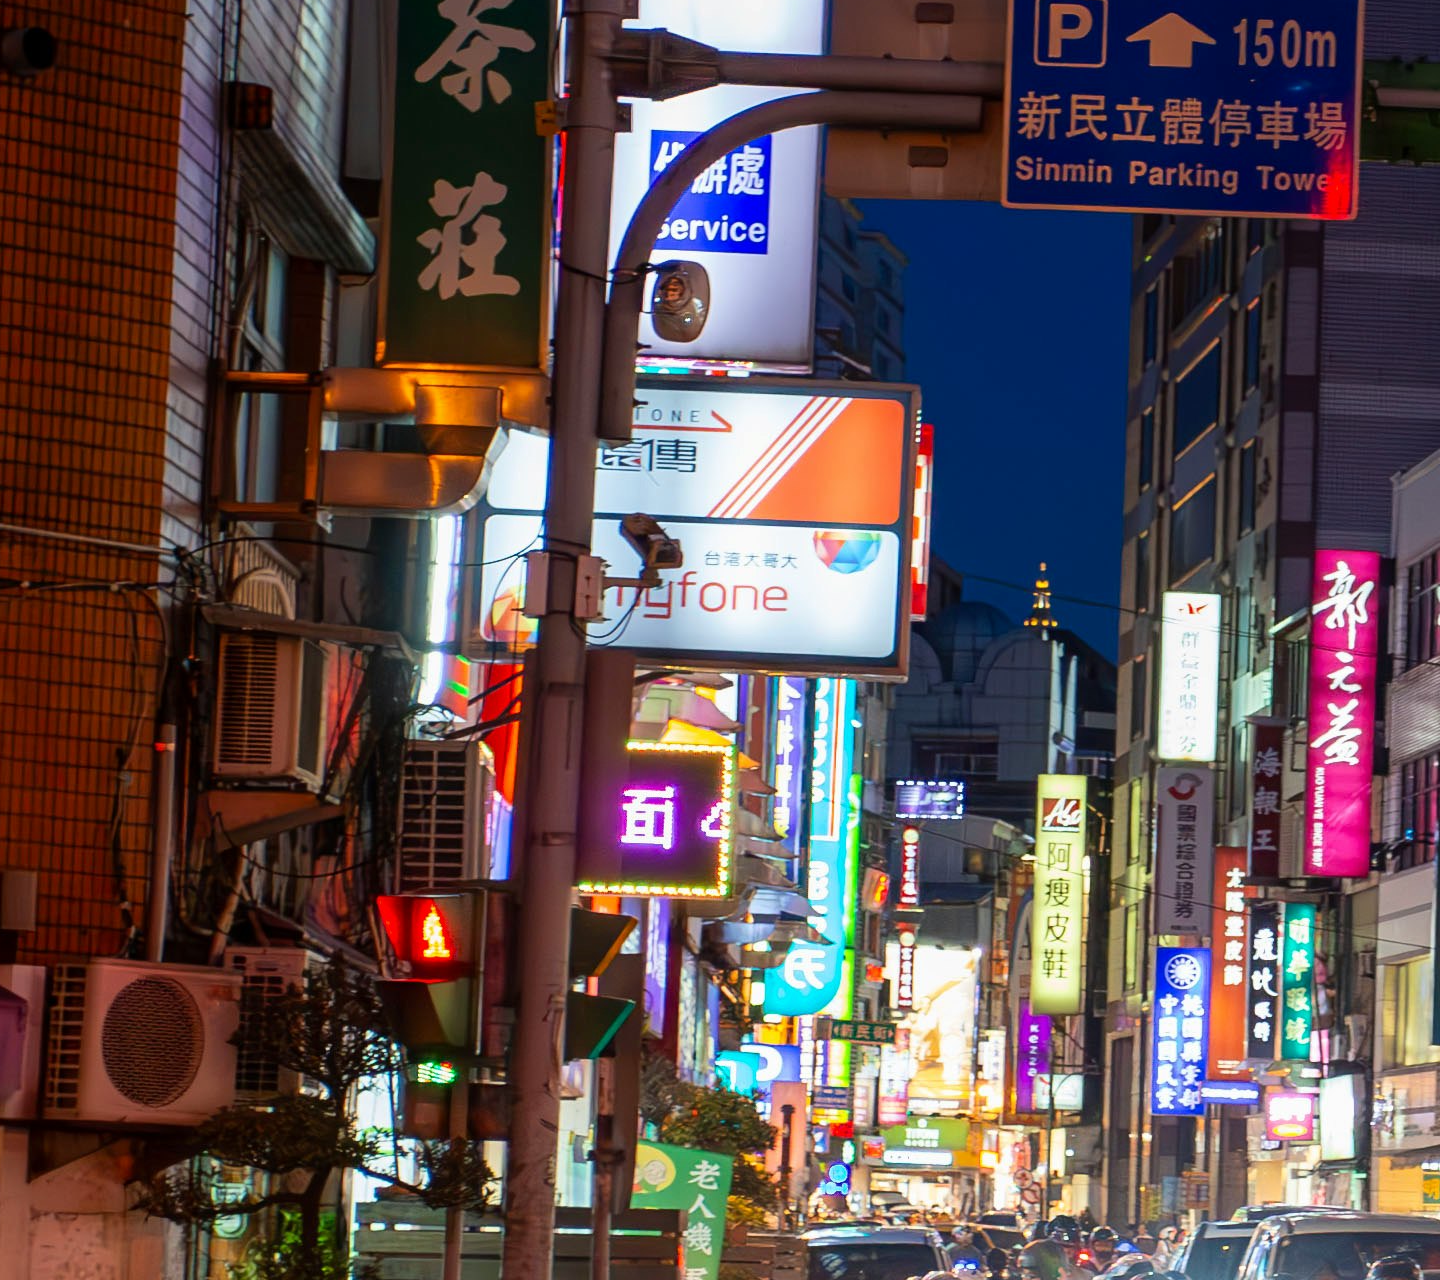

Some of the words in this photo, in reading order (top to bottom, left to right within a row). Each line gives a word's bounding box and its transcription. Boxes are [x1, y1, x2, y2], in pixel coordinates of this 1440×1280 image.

[1048, 3, 1093, 58] P
[1233, 18, 1338, 69] 150m
[1016, 91, 1349, 151] 新民立體停車場
[1015, 154, 1113, 184] Sinmin
[1128, 160, 1240, 195] Parking
[1255, 165, 1351, 192] Tower
[1309, 561, 1375, 767] 郭元益
[1042, 841, 1073, 980] 阿瘦皮鞋
